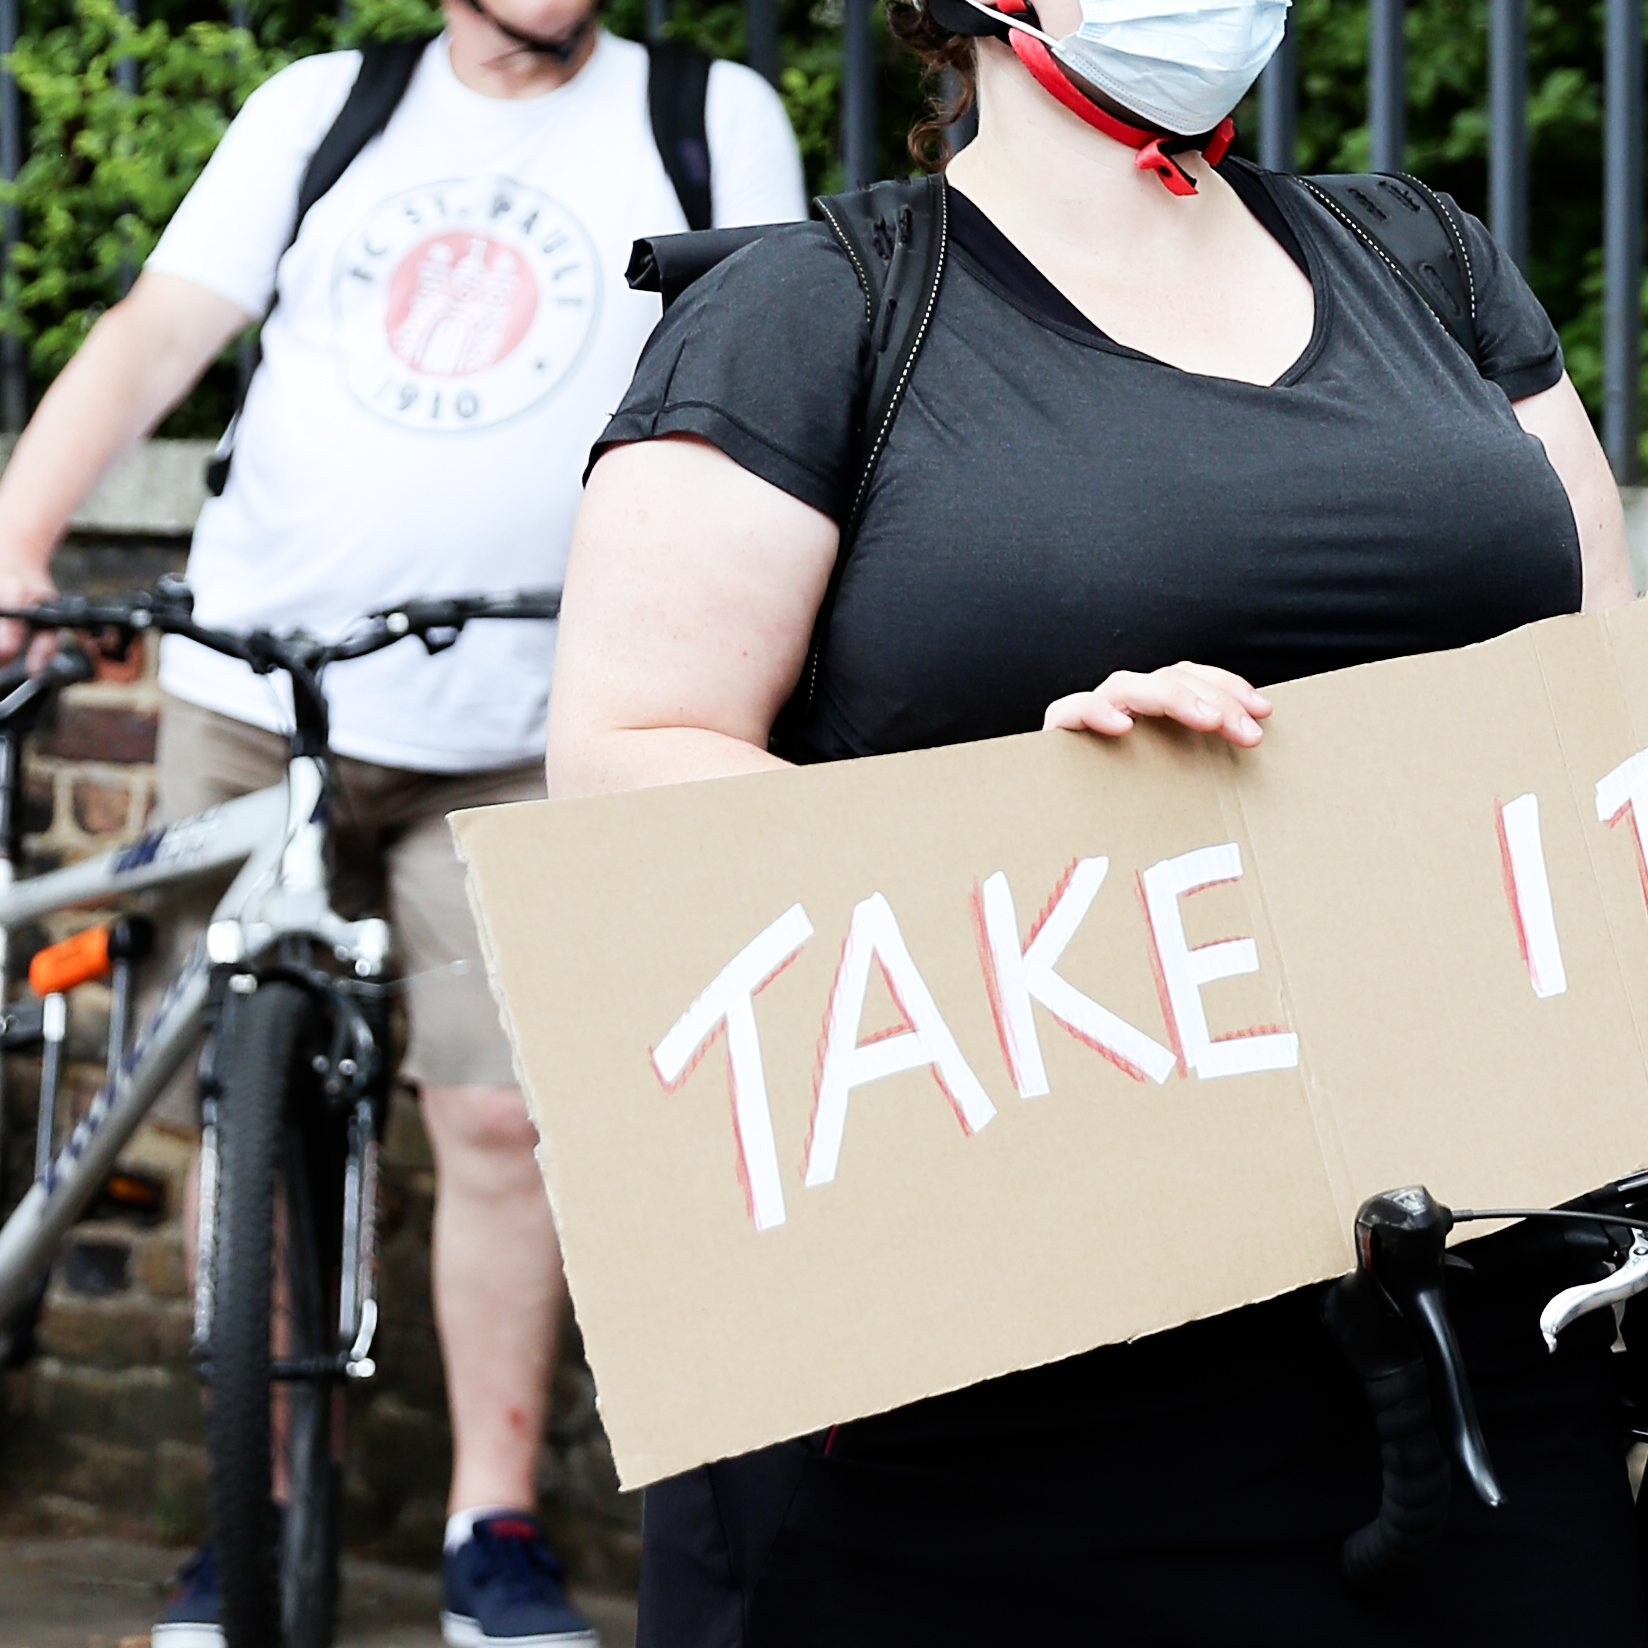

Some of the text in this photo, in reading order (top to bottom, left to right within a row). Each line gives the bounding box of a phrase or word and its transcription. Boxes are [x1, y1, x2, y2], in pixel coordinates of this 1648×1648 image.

[349, 235, 389, 284] FC
[489, 189, 585, 308] PAULI
[651, 840, 1300, 1233] TAKE
